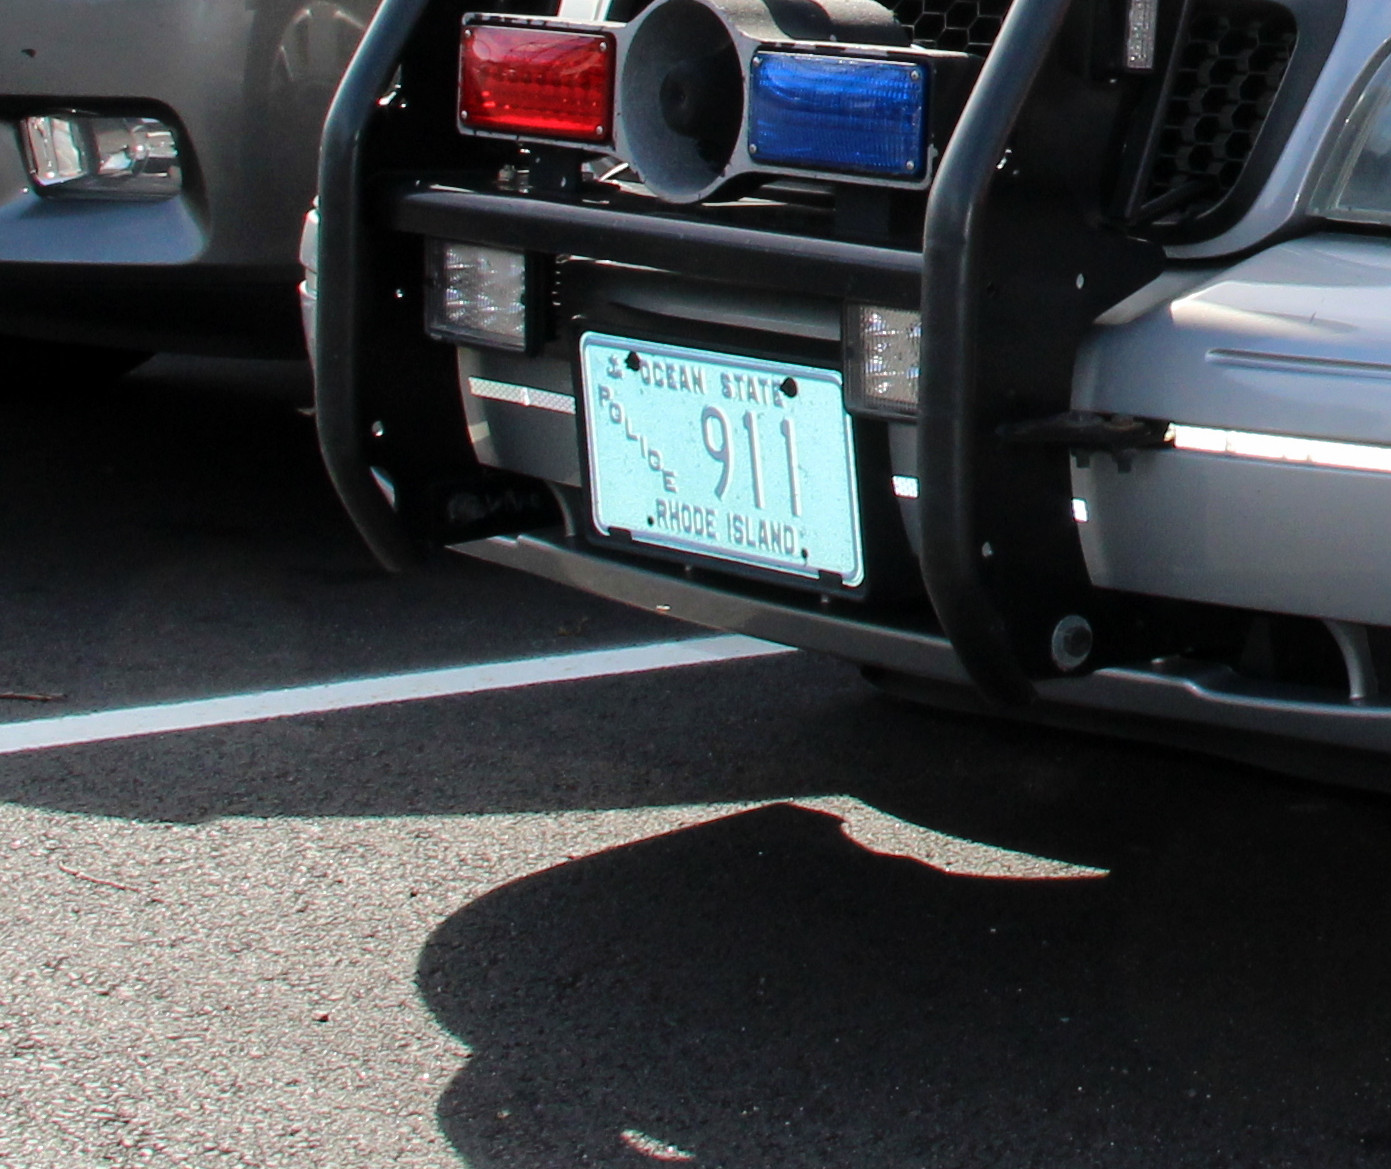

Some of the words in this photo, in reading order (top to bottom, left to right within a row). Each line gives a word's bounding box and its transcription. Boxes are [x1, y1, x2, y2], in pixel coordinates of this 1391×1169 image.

[640, 360, 706, 395] OCEAN
[720, 373, 786, 408] STATE
[598, 384, 678, 493] POLICE
[701, 405, 801, 518] 911
[655, 498, 718, 541] RHODE
[727, 512, 797, 556] ISLAND
